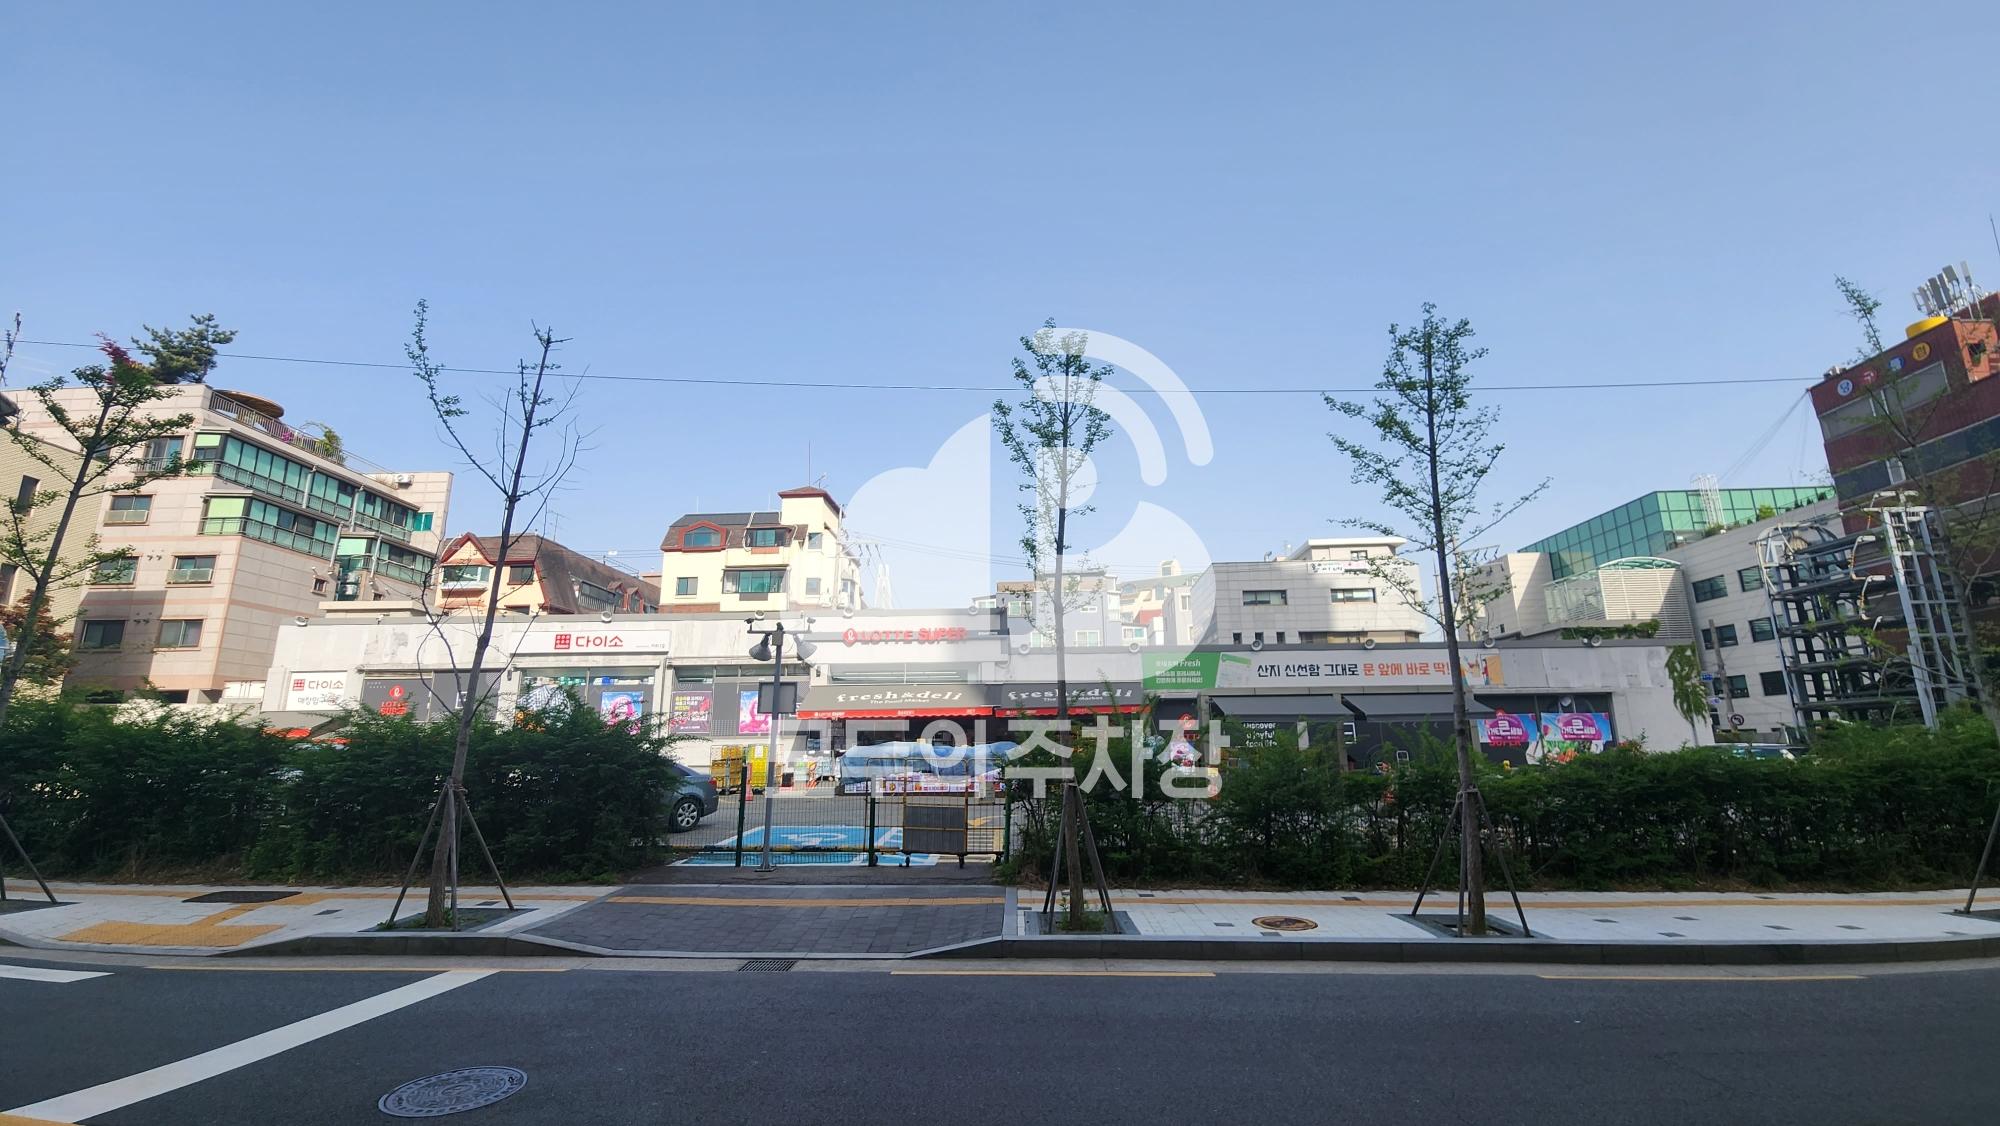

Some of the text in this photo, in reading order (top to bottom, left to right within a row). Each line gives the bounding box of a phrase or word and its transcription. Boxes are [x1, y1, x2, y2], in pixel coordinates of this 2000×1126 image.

[860, 627, 967, 642] LOTTE SUPER
[575, 635, 623, 648] 다이소
[1257, 662, 1450, 678] 산지 신선함 그대로 문 앞에 바로 딱!
[308, 680, 344, 689] 다이소
[836, 691, 962, 703] fresh&deli
